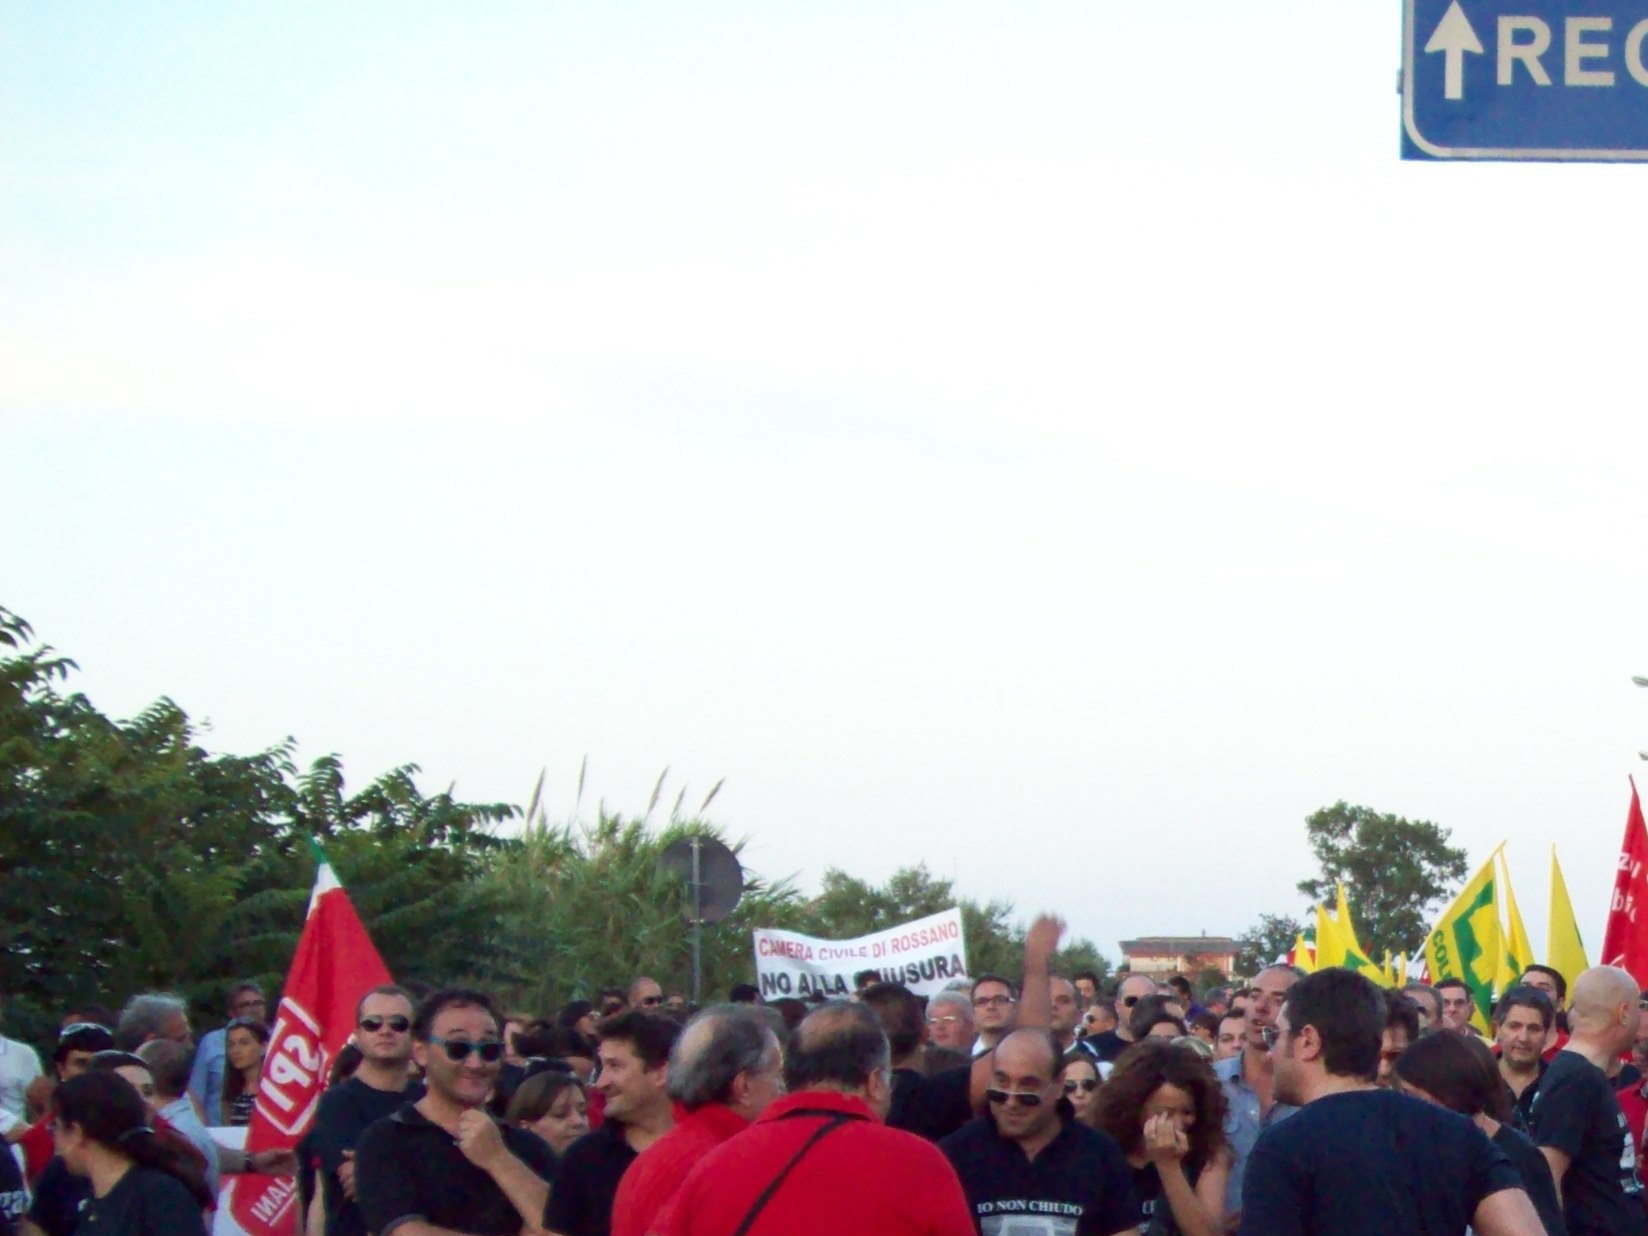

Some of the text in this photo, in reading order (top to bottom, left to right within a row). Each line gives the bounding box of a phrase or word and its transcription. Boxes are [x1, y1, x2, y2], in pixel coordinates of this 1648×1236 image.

[758, 920, 959, 961] CAMERA CIVILE DI ROSSANO
[760, 953, 965, 997] NO ALLA IUSURA
[977, 1200, 1083, 1216] IO NON CHIUDO
